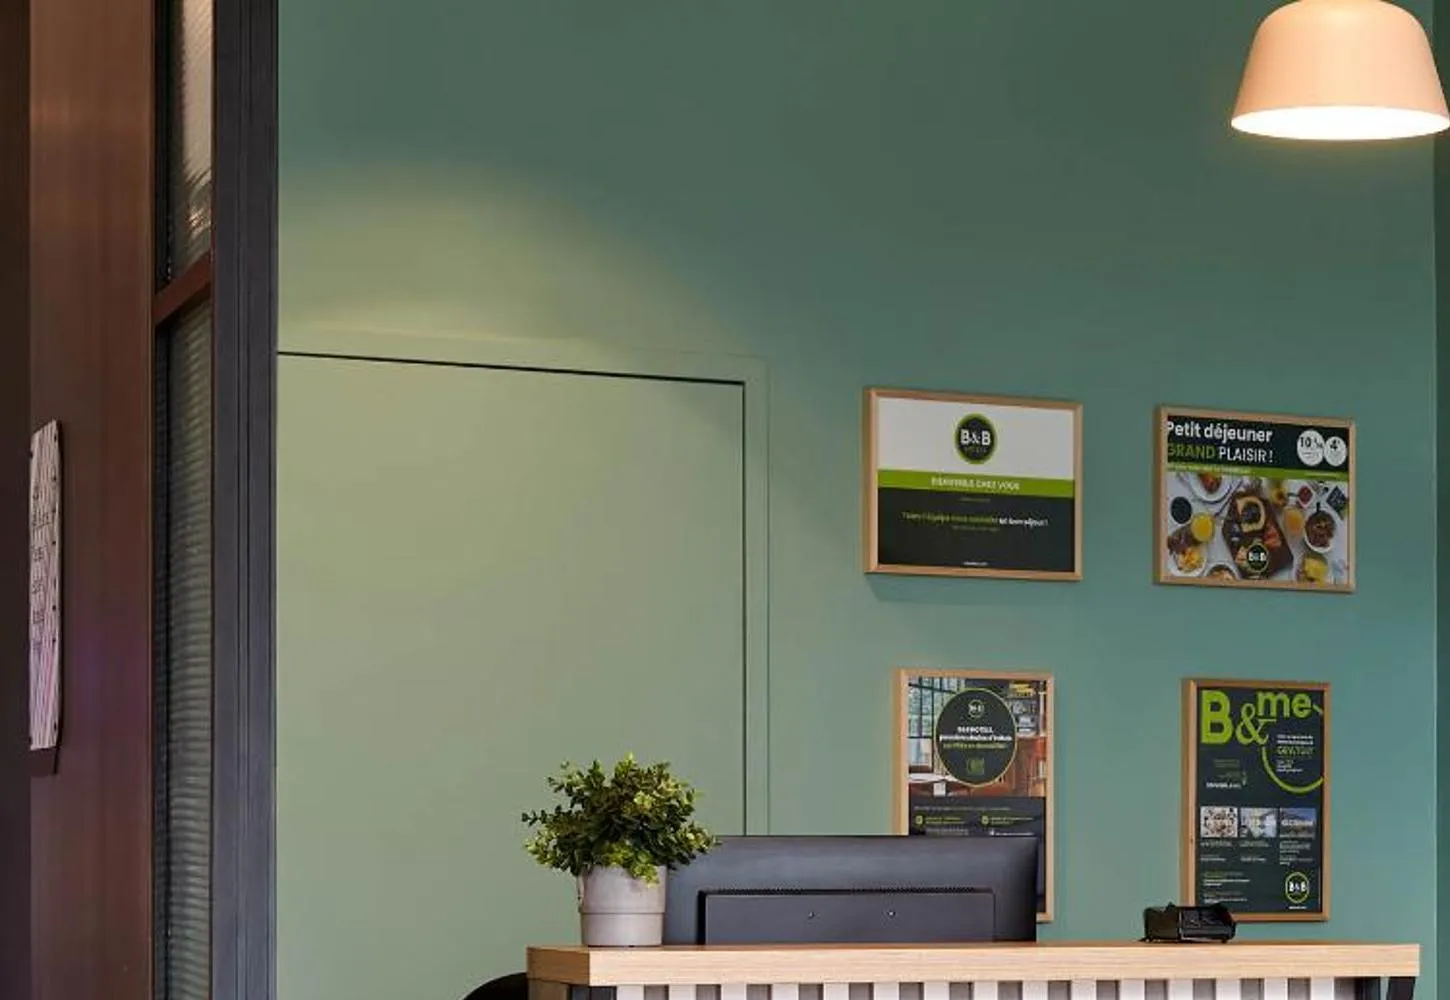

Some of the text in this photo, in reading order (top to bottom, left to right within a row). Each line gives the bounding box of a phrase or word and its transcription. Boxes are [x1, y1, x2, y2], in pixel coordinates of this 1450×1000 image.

[960, 428, 992, 447] B&B
[1168, 421, 1274, 444] Petit déjeuner
[1168, 443, 1217, 460] GRAND
[1218, 446, 1267, 463] PLAISIR
